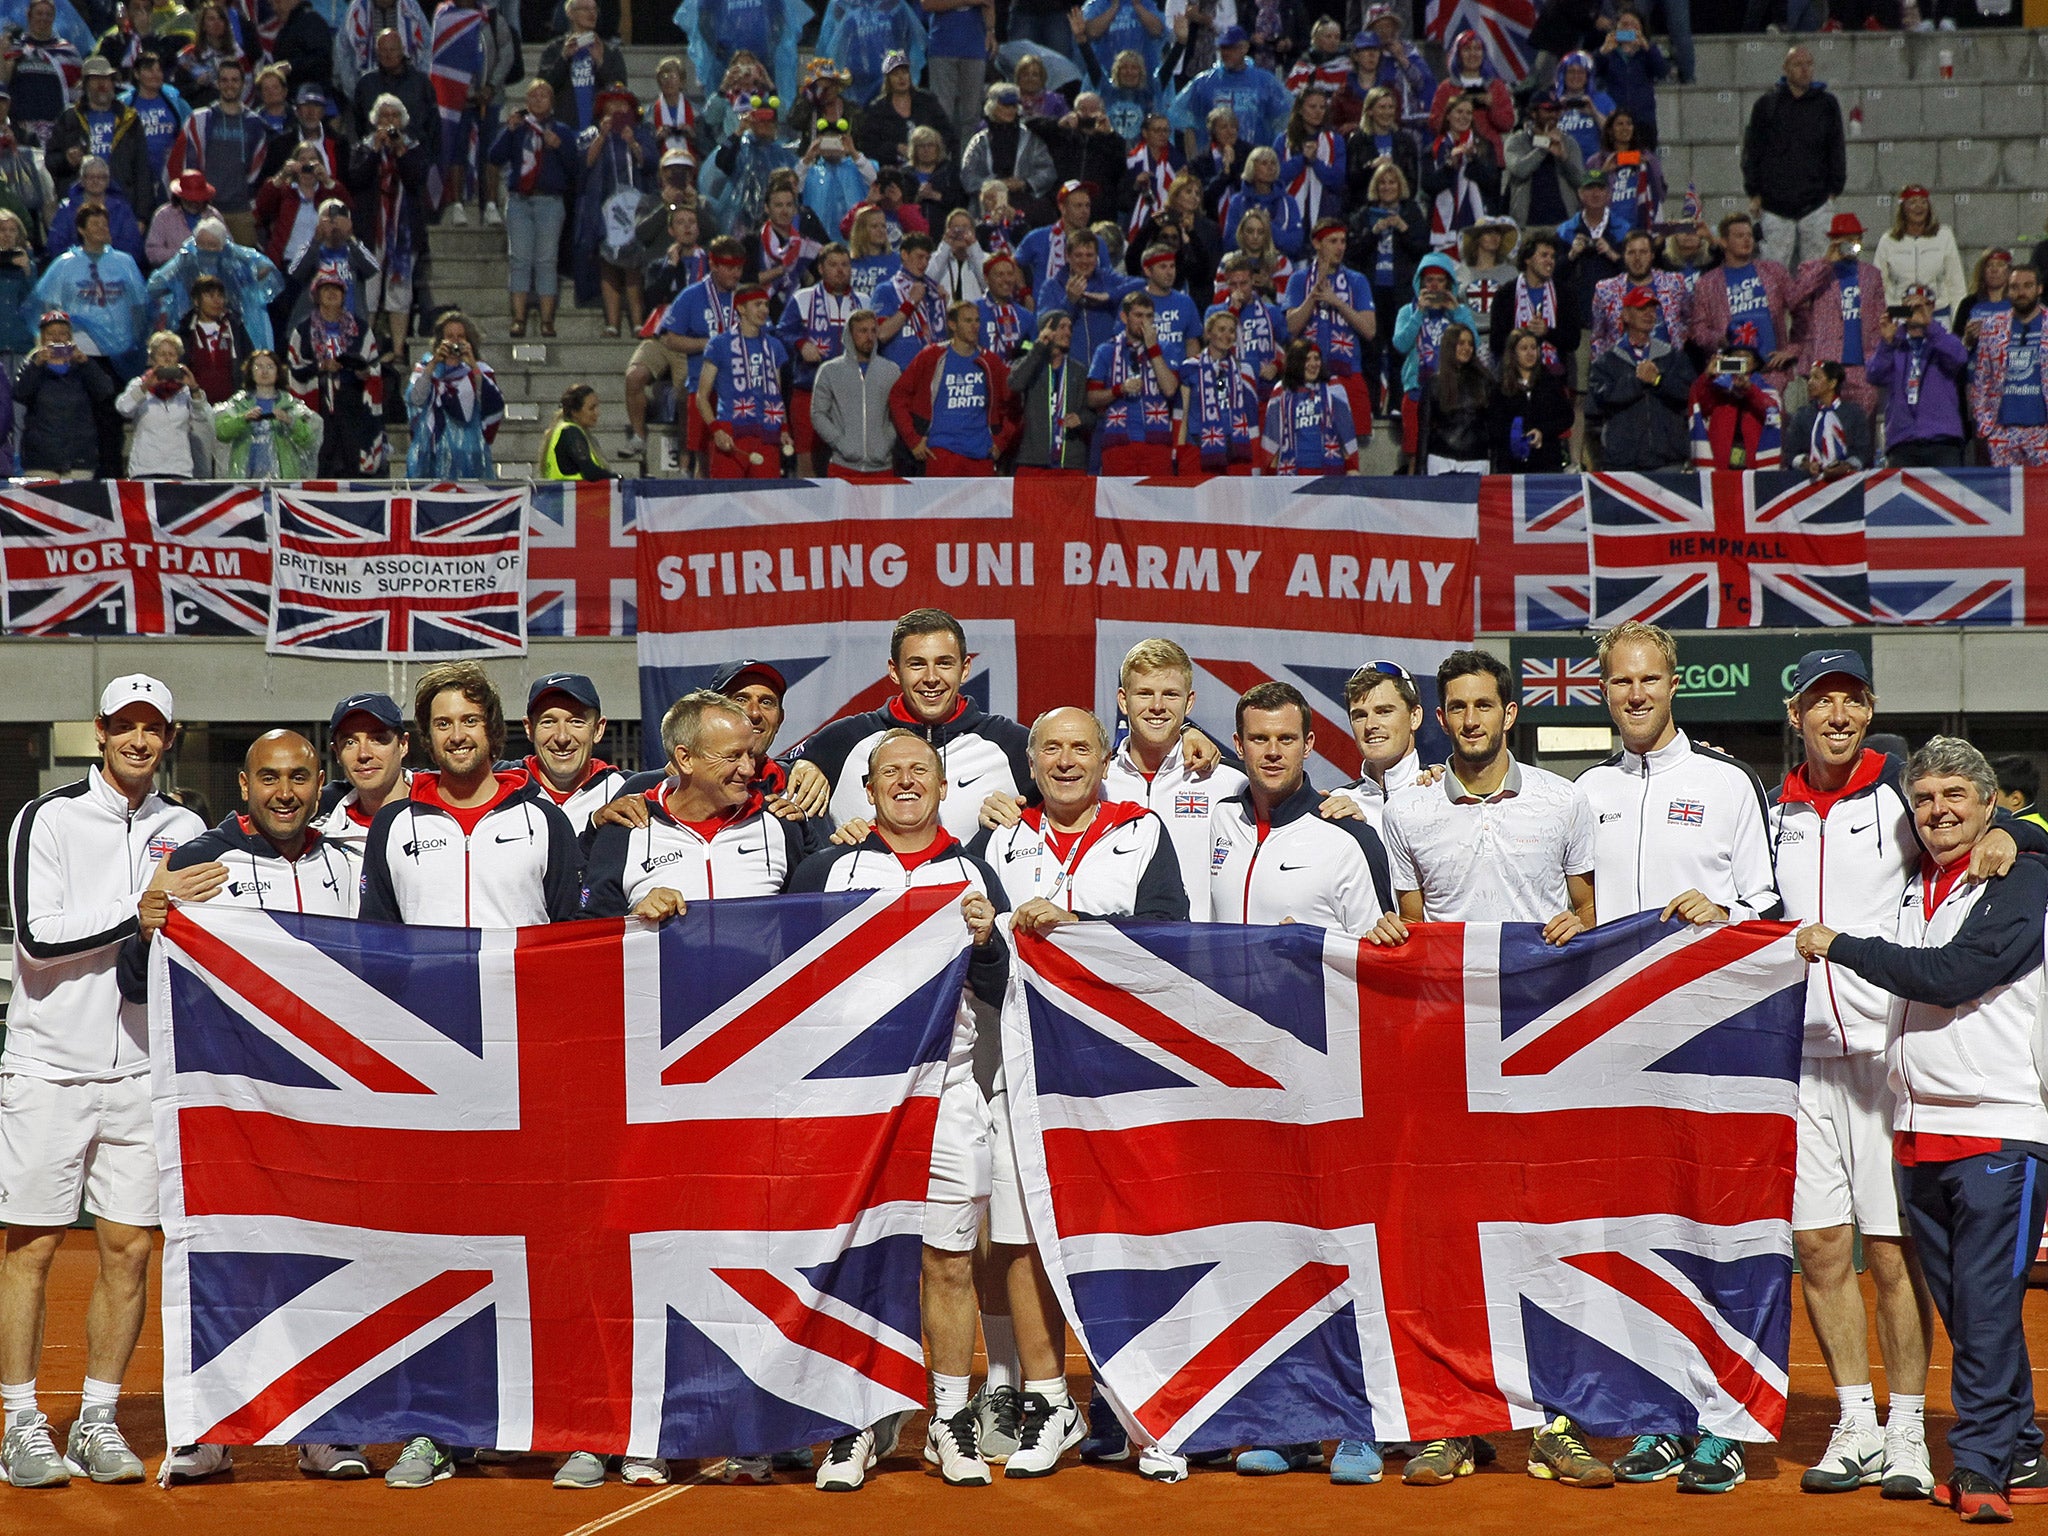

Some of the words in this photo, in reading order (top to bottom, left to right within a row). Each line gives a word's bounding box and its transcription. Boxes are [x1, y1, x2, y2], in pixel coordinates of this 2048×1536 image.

[945, 372, 984, 386] BACK
[947, 385, 974, 397] THE
[947, 396, 985, 409] BRITS
[45, 542, 241, 576] WORTHAM
[279, 552, 347, 576] BRITISH
[362, 560, 486, 575] ASSOCIATION
[496, 555, 521, 571] OF
[299, 573, 362, 594] TENNIS
[378, 574, 497, 592] SUPPORTERS
[657, 543, 909, 600] STIRLING
[936, 542, 1035, 587] UNI
[1063, 541, 1262, 593] BARMY
[1285, 553, 1456, 606] ARMY
[1721, 583, 1734, 600] T
[1737, 597, 1749, 613] C
[100, 600, 123, 625] T
[175, 601, 200, 625] C
[1676, 662, 1750, 690] EGON
